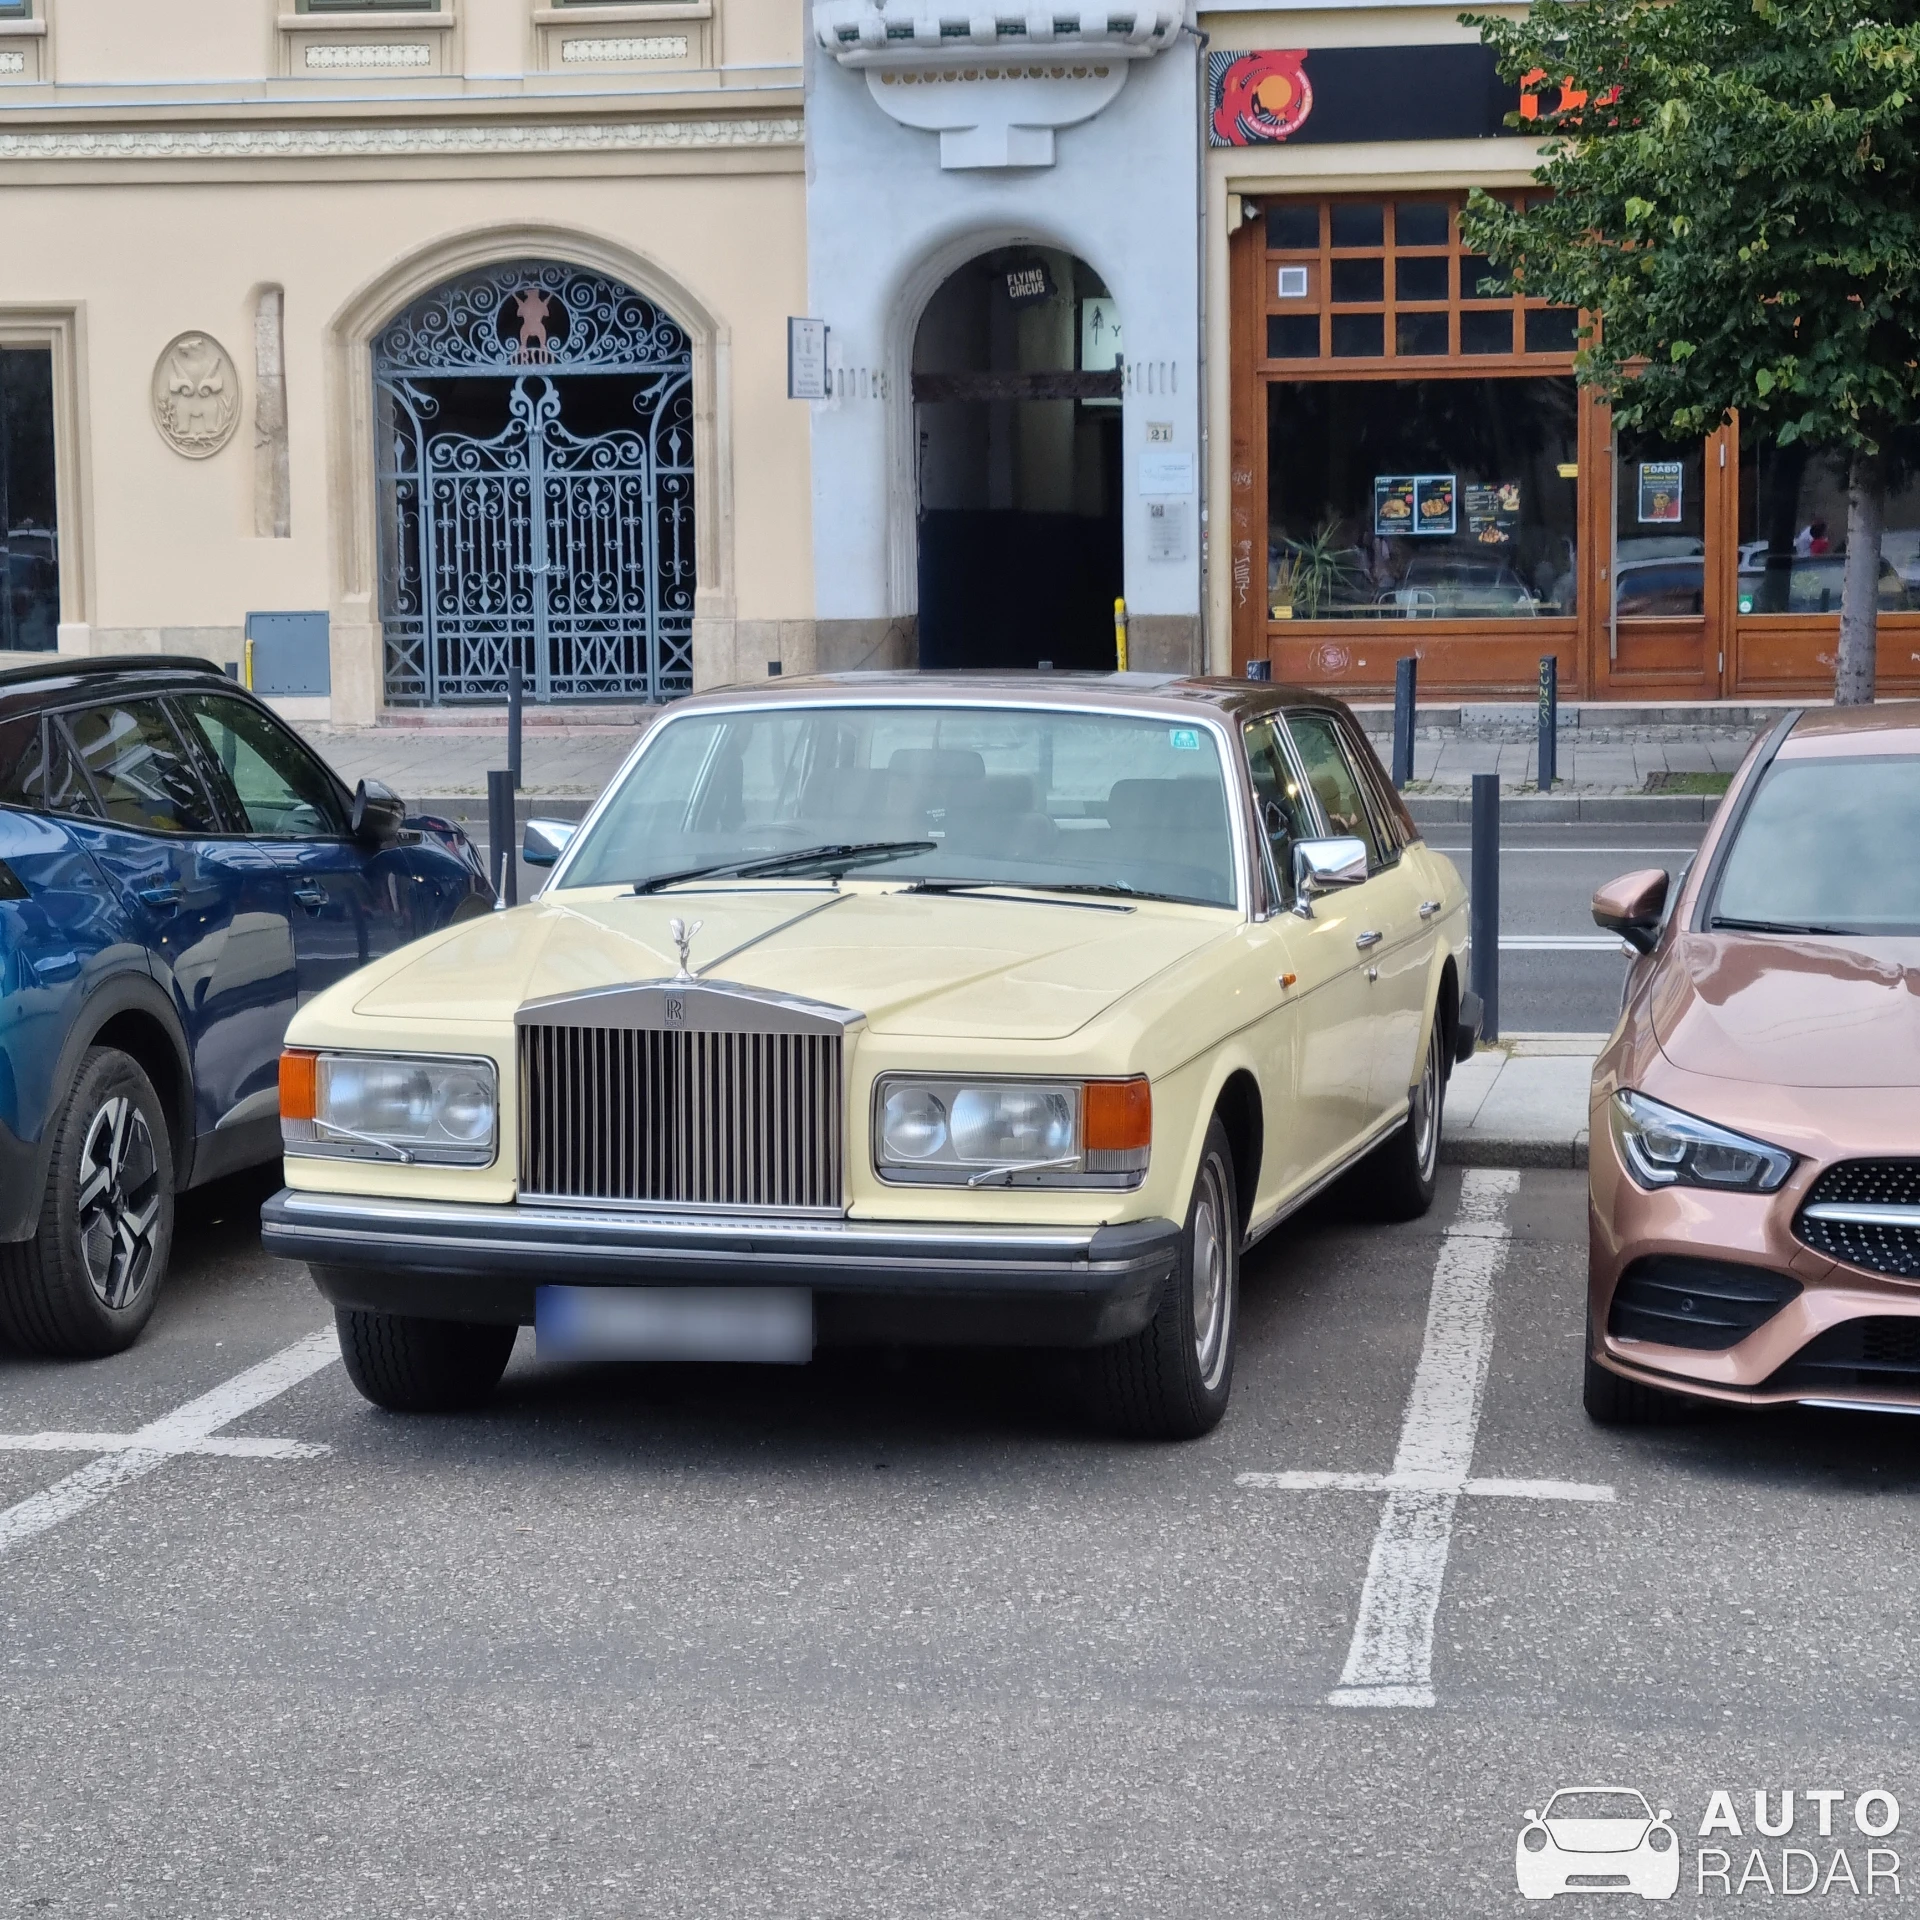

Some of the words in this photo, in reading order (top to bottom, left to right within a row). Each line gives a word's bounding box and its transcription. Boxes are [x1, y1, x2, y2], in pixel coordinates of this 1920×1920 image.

[1007, 269, 1044, 287] FLYING
[1009, 281, 1046, 298] CIRCUS
[1151, 429, 1169, 441] 21
[1650, 465, 1678, 473] DABO
[667, 999, 682, 1020] RR
